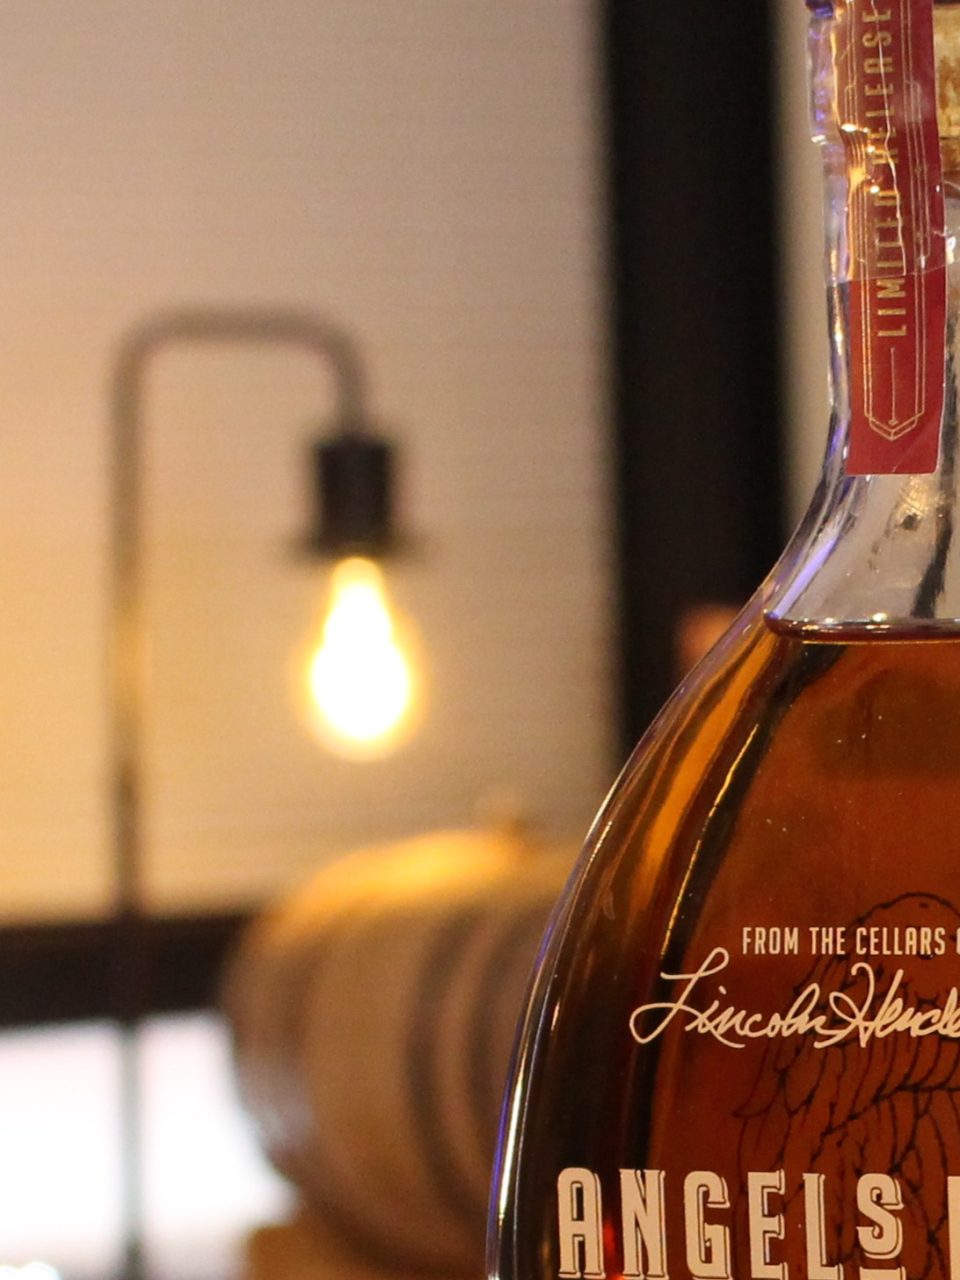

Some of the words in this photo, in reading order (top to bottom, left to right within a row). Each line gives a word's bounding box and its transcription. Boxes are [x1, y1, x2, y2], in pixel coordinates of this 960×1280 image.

[862, 9, 899, 165] RELEASE
[873, 189, 907, 337] LIMITED
[742, 926, 799, 955] FROM
[809, 926, 846, 955] THE
[855, 927, 946, 956] CELLARS
